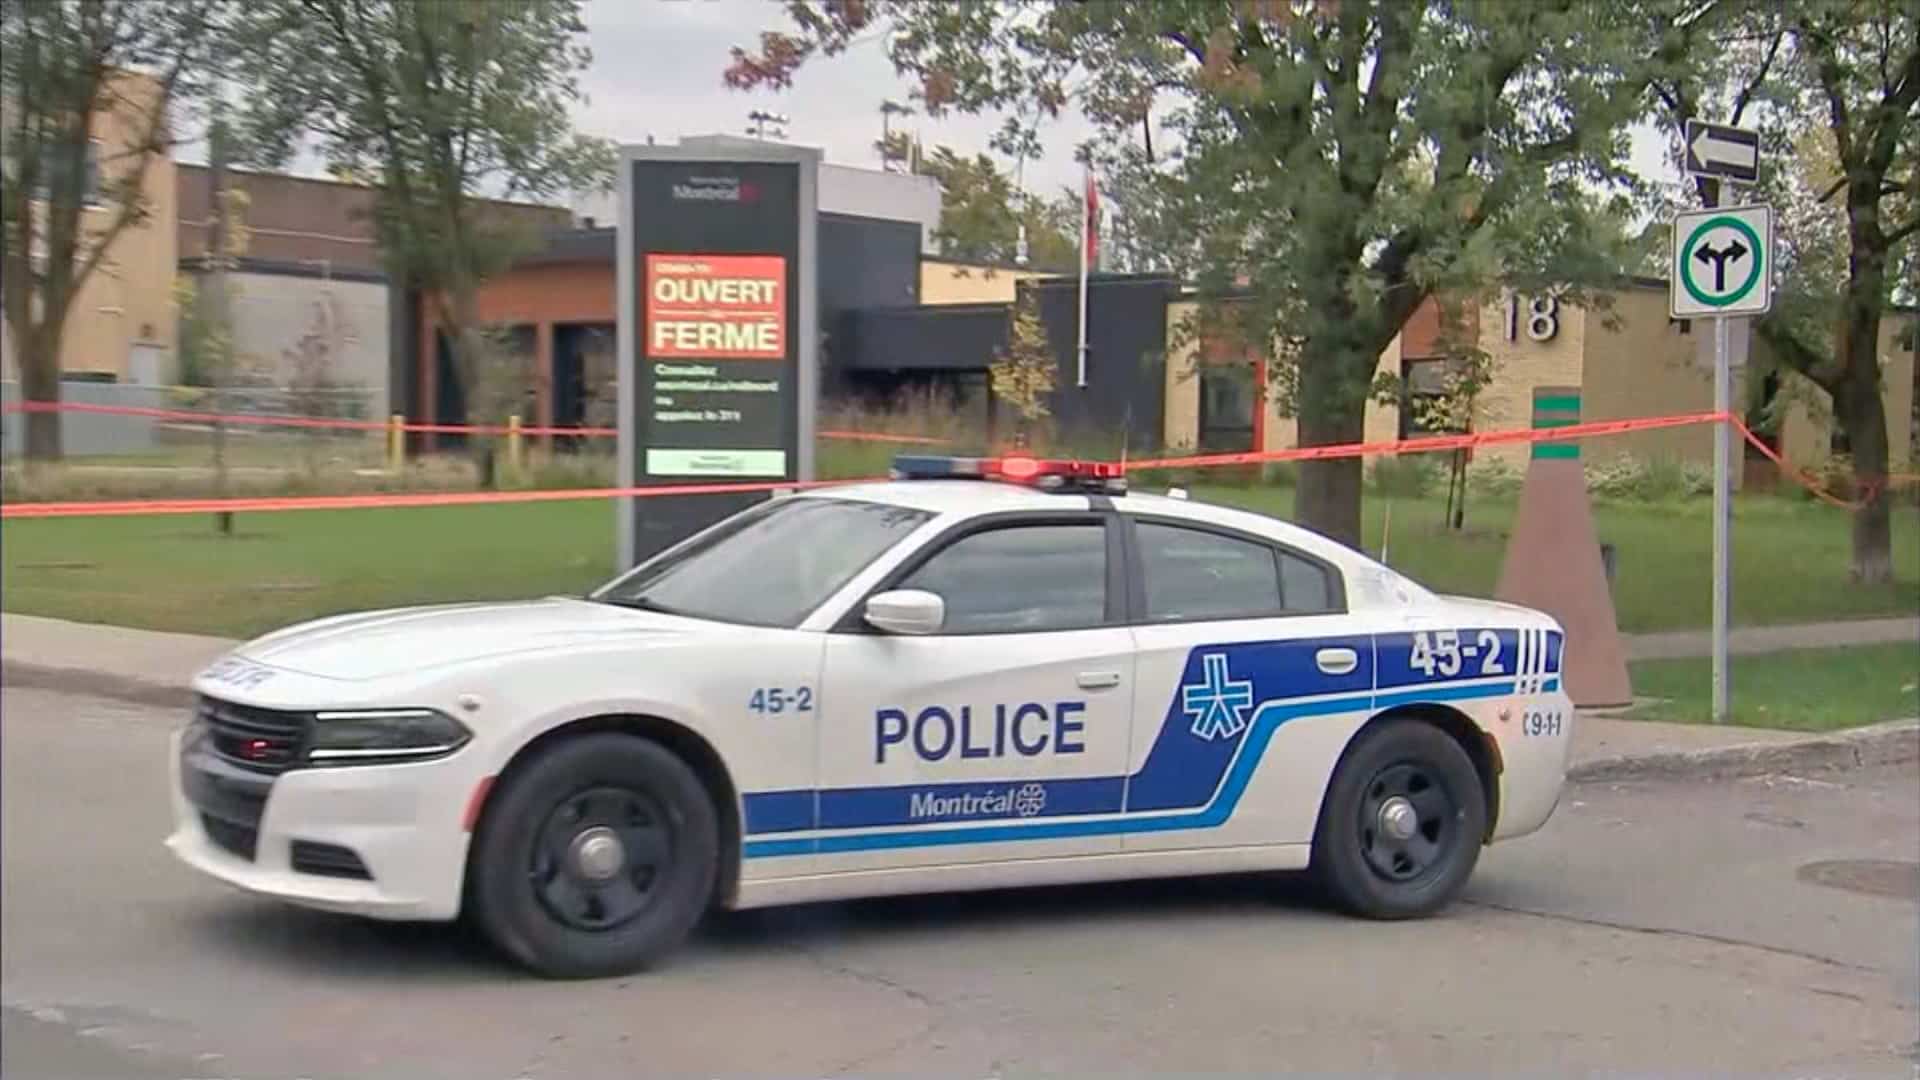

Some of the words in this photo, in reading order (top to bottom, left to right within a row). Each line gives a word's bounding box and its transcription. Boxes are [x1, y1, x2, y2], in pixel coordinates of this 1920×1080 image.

[655, 277, 777, 304] OUVERT
[1500, 287, 1559, 341] 18
[655, 316, 779, 351] FERMÉ
[1410, 630, 1505, 677] 45-2
[749, 686, 812, 713] 45-2
[875, 701, 1086, 764] POLICE
[1531, 711, 1562, 736] 9-1-1
[910, 787, 1016, 818] Montréal
